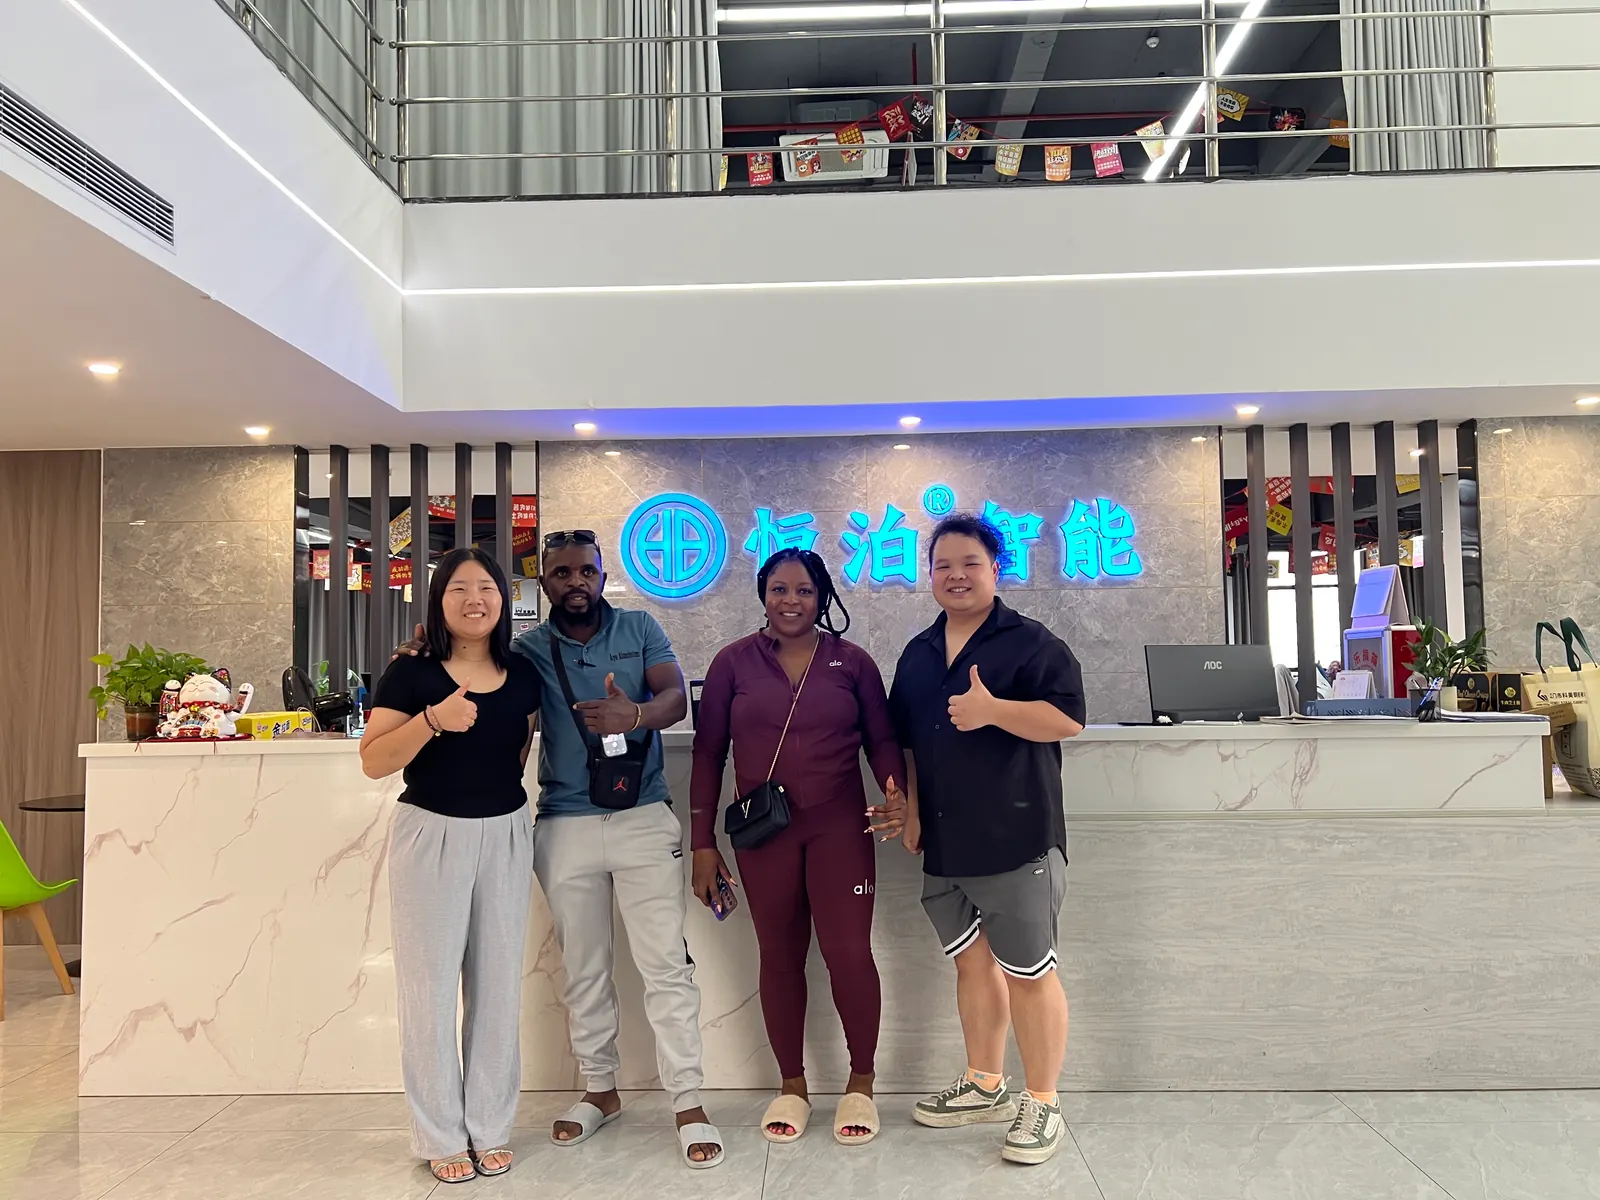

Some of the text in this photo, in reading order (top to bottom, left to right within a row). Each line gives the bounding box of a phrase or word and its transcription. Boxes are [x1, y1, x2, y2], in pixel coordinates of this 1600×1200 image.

[829, 659, 842, 667] alo
[1203, 660, 1223, 670] AOC
[853, 879, 874, 895] alo
